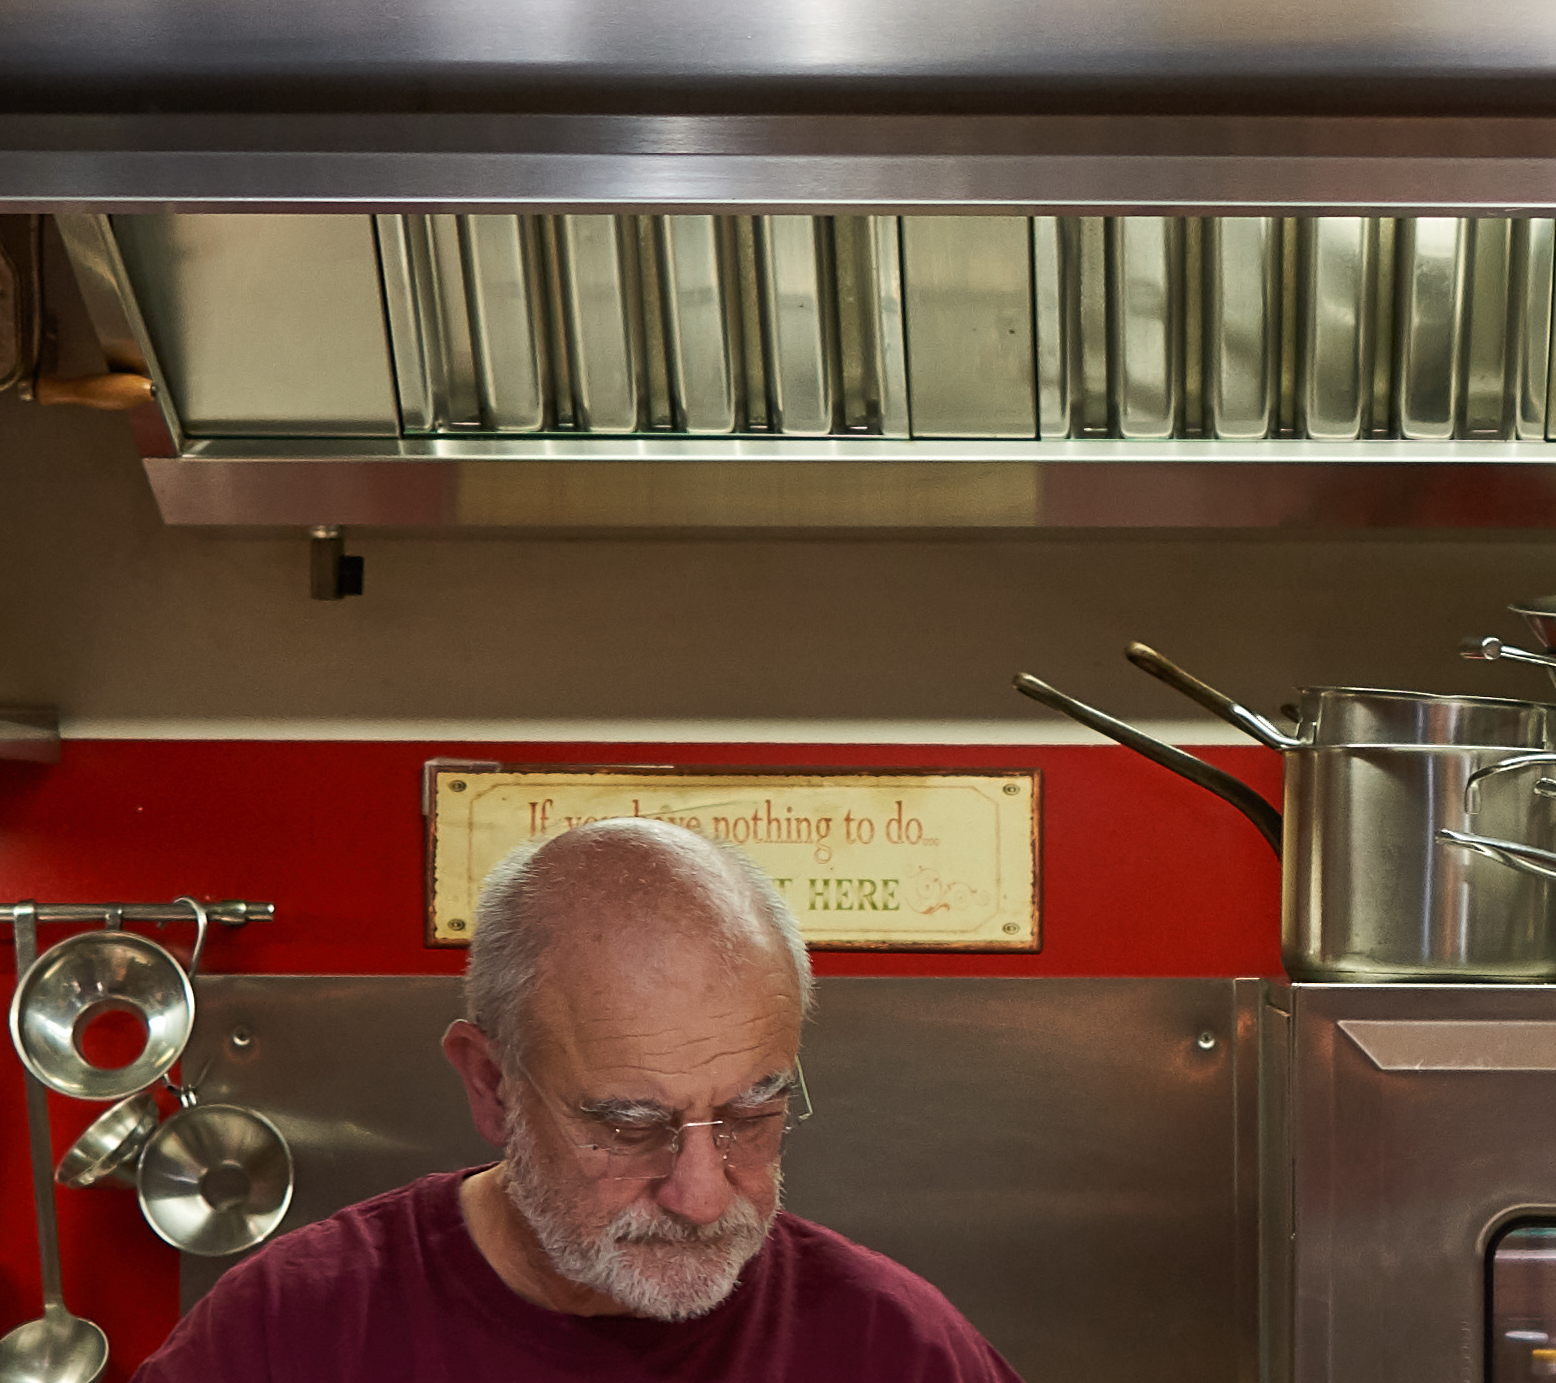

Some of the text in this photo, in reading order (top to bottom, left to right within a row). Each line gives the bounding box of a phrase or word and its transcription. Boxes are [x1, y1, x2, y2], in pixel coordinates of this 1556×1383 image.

[528, 798, 554, 836] If
[712, 799, 833, 865] nothing
[844, 807, 875, 845] to
[809, 878, 901, 911] HERE
